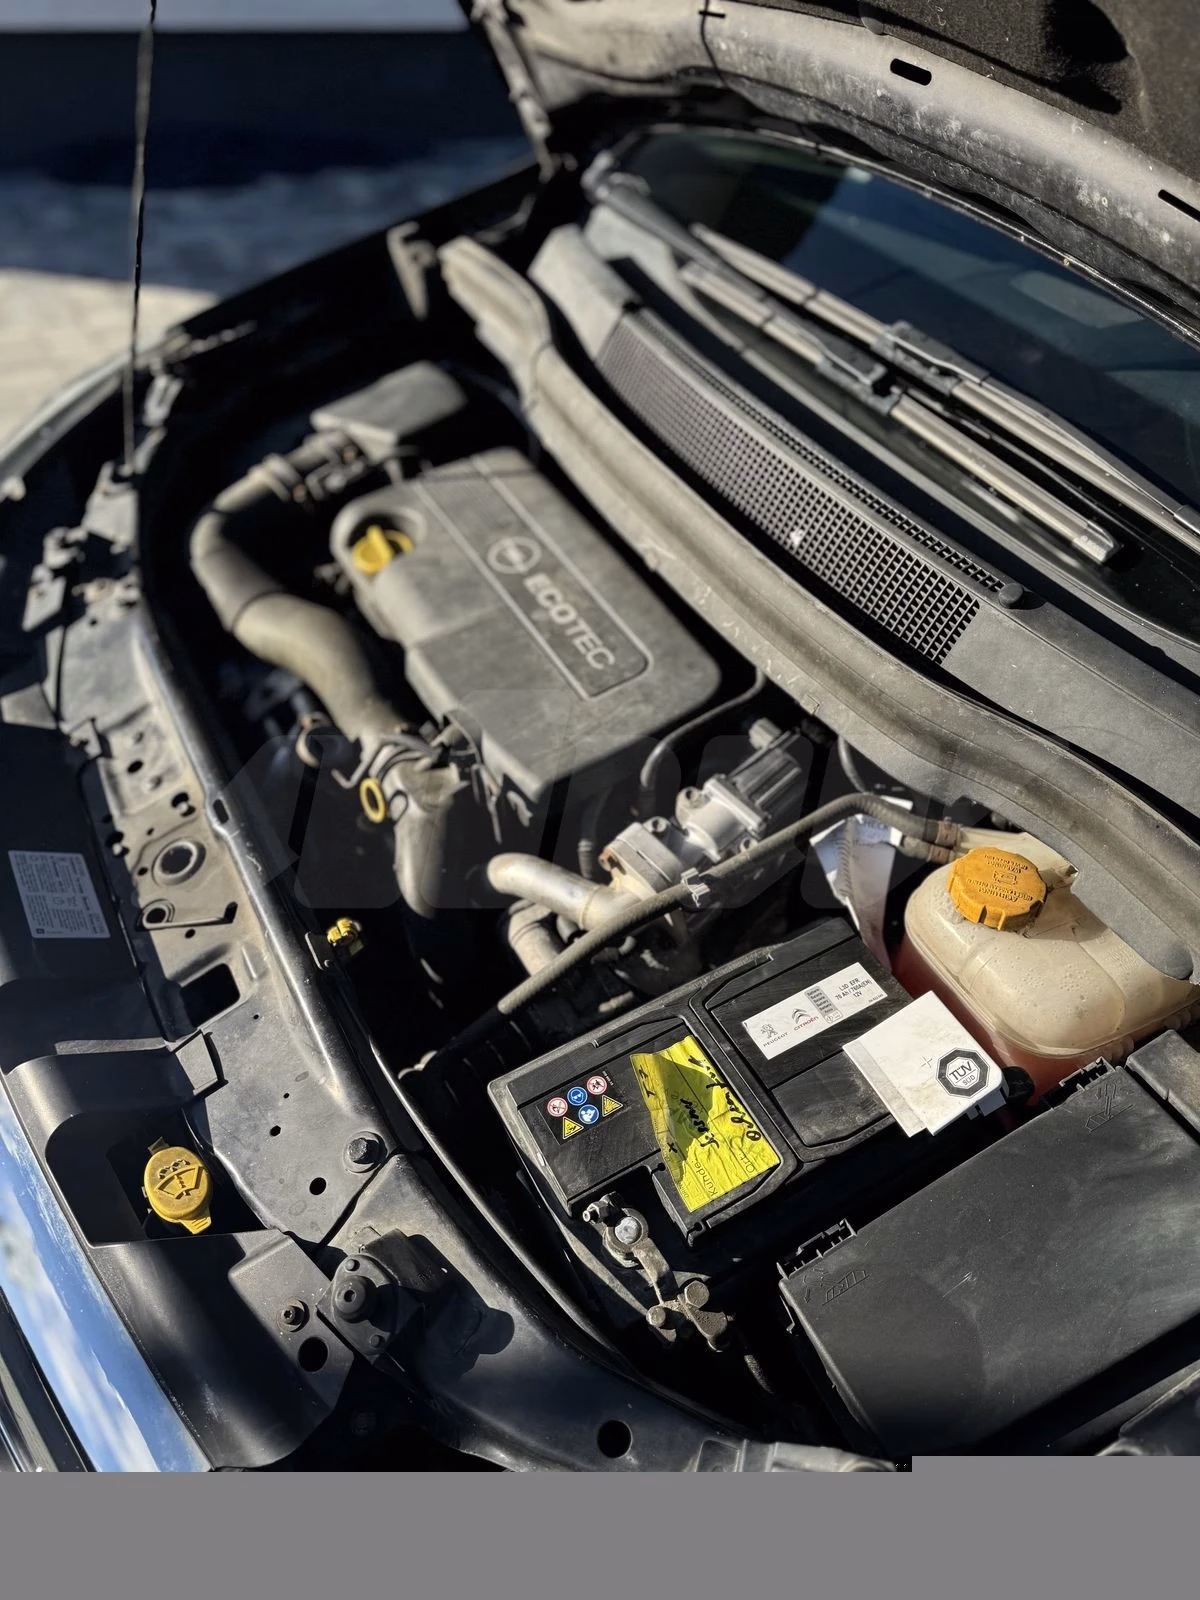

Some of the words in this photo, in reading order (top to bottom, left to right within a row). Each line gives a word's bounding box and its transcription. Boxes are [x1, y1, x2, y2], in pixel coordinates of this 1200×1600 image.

[523, 572, 616, 670] ECOTEC
[763, 1032, 789, 1047] PEUGEOT
[949, 1061, 972, 1080] TÜV
[962, 1075, 976, 1085] SÜD
[738, 1153, 756, 1174] Ort:
[694, 1157, 719, 1197] Kunde:
